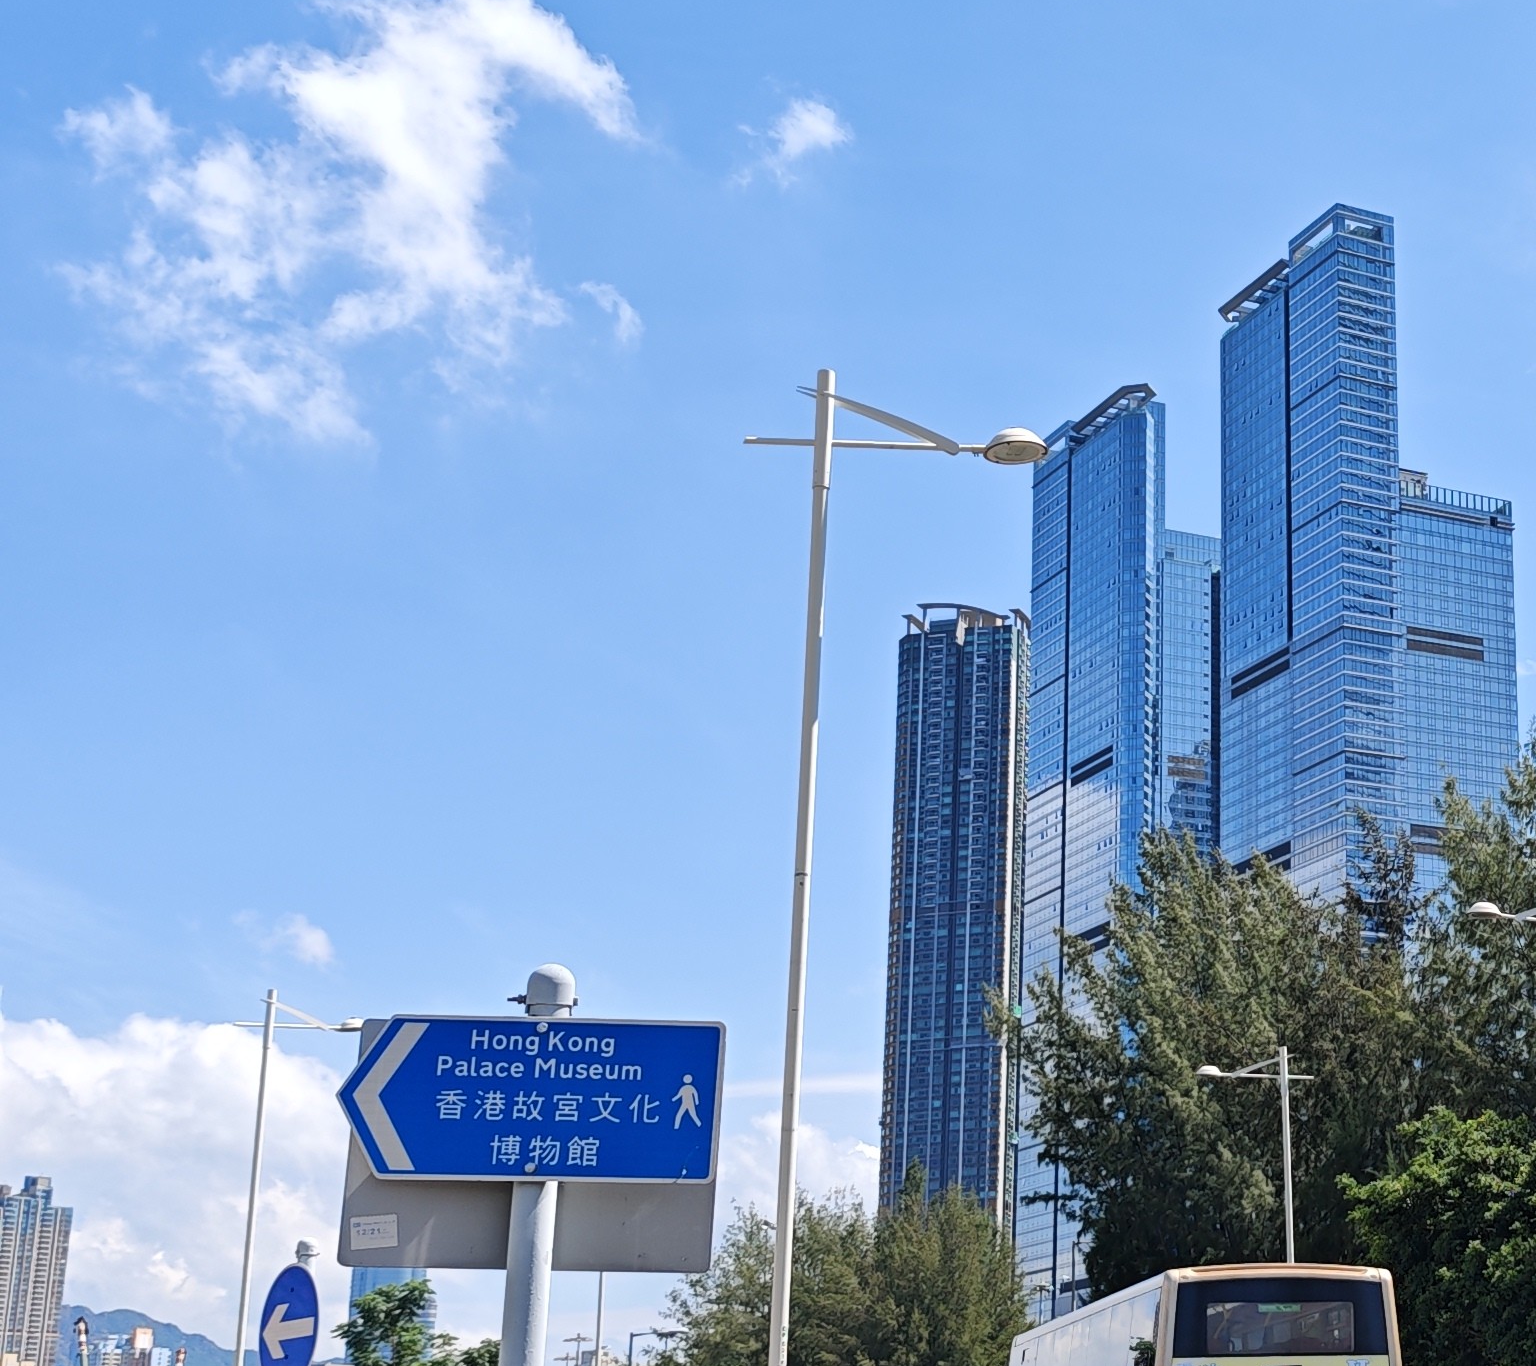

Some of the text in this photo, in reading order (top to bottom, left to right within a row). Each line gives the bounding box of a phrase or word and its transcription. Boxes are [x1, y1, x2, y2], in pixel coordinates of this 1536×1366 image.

[470, 1029, 615, 1057] Hong Kong
[437, 1055, 642, 1081] Palace Museum
[435, 1090, 661, 1124] 香港故宮文化
[490, 1134, 600, 1167] 博物館
